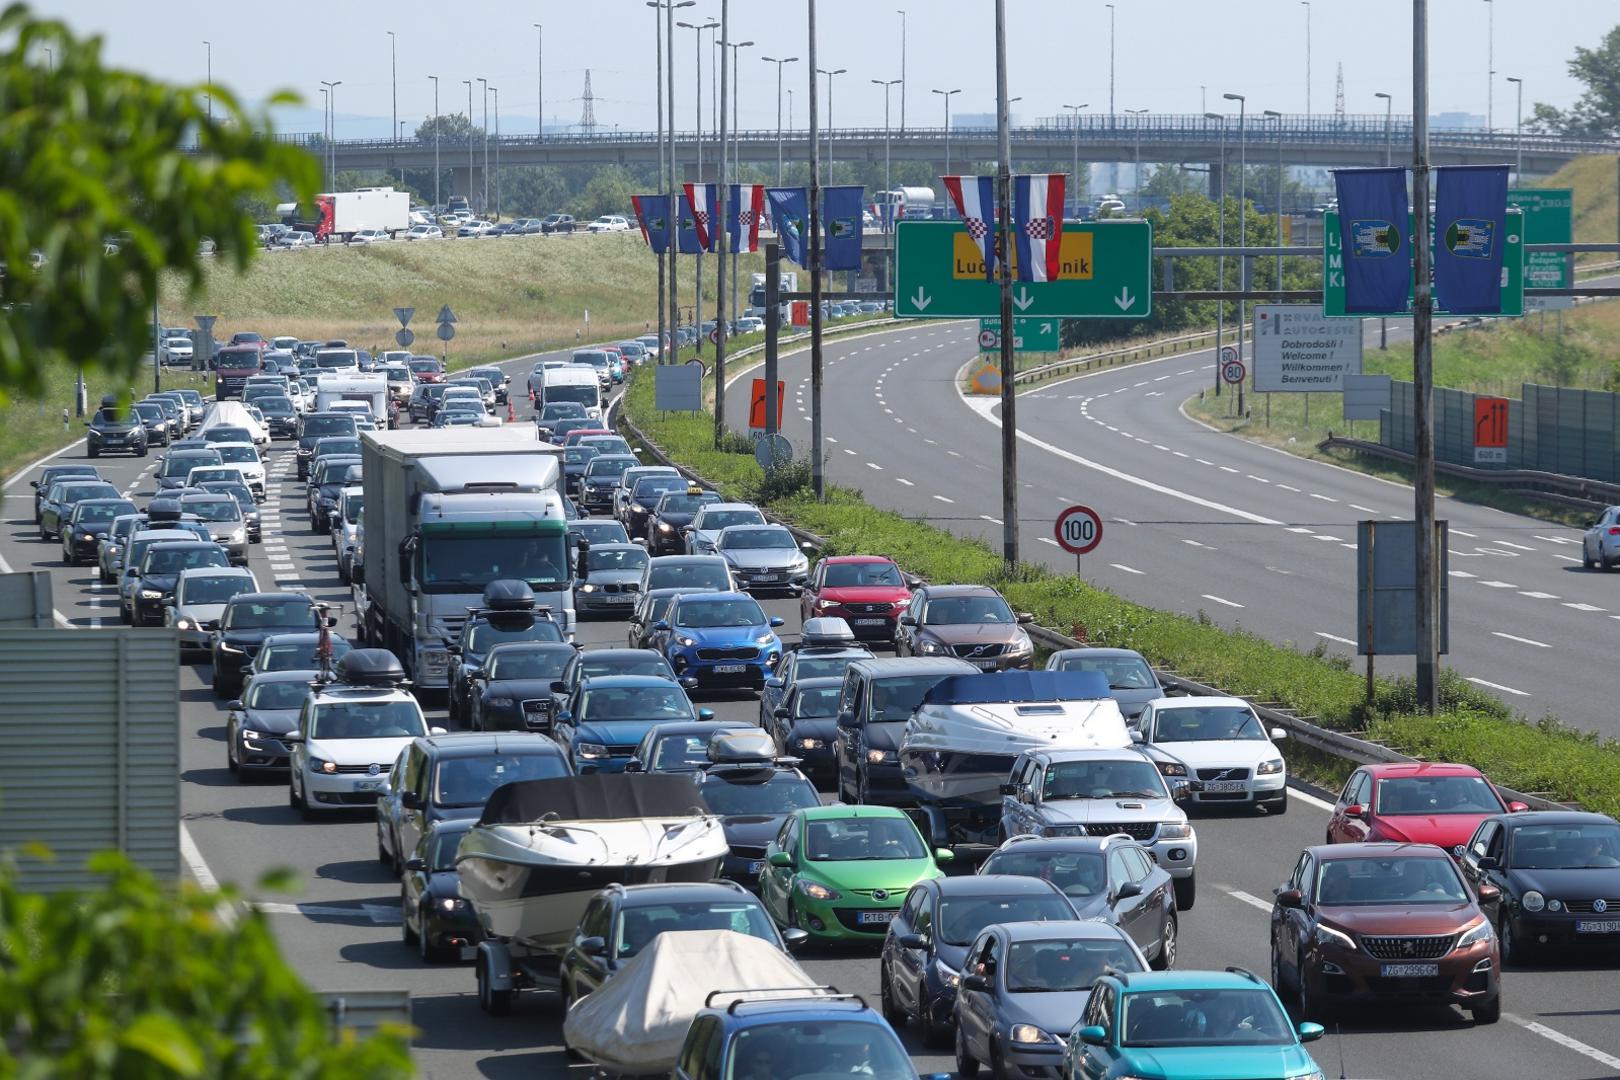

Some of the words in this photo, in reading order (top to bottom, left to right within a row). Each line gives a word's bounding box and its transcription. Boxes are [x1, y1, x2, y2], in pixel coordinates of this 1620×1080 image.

[1281, 340, 1337, 349] Dobrodošli
[1281, 351, 1328, 360] Welcome
[1281, 363, 1344, 372] Willkommen
[1227, 366, 1241, 379] 80
[1281, 374, 1333, 384] Benvenuti
[1064, 520, 1093, 540] 100
